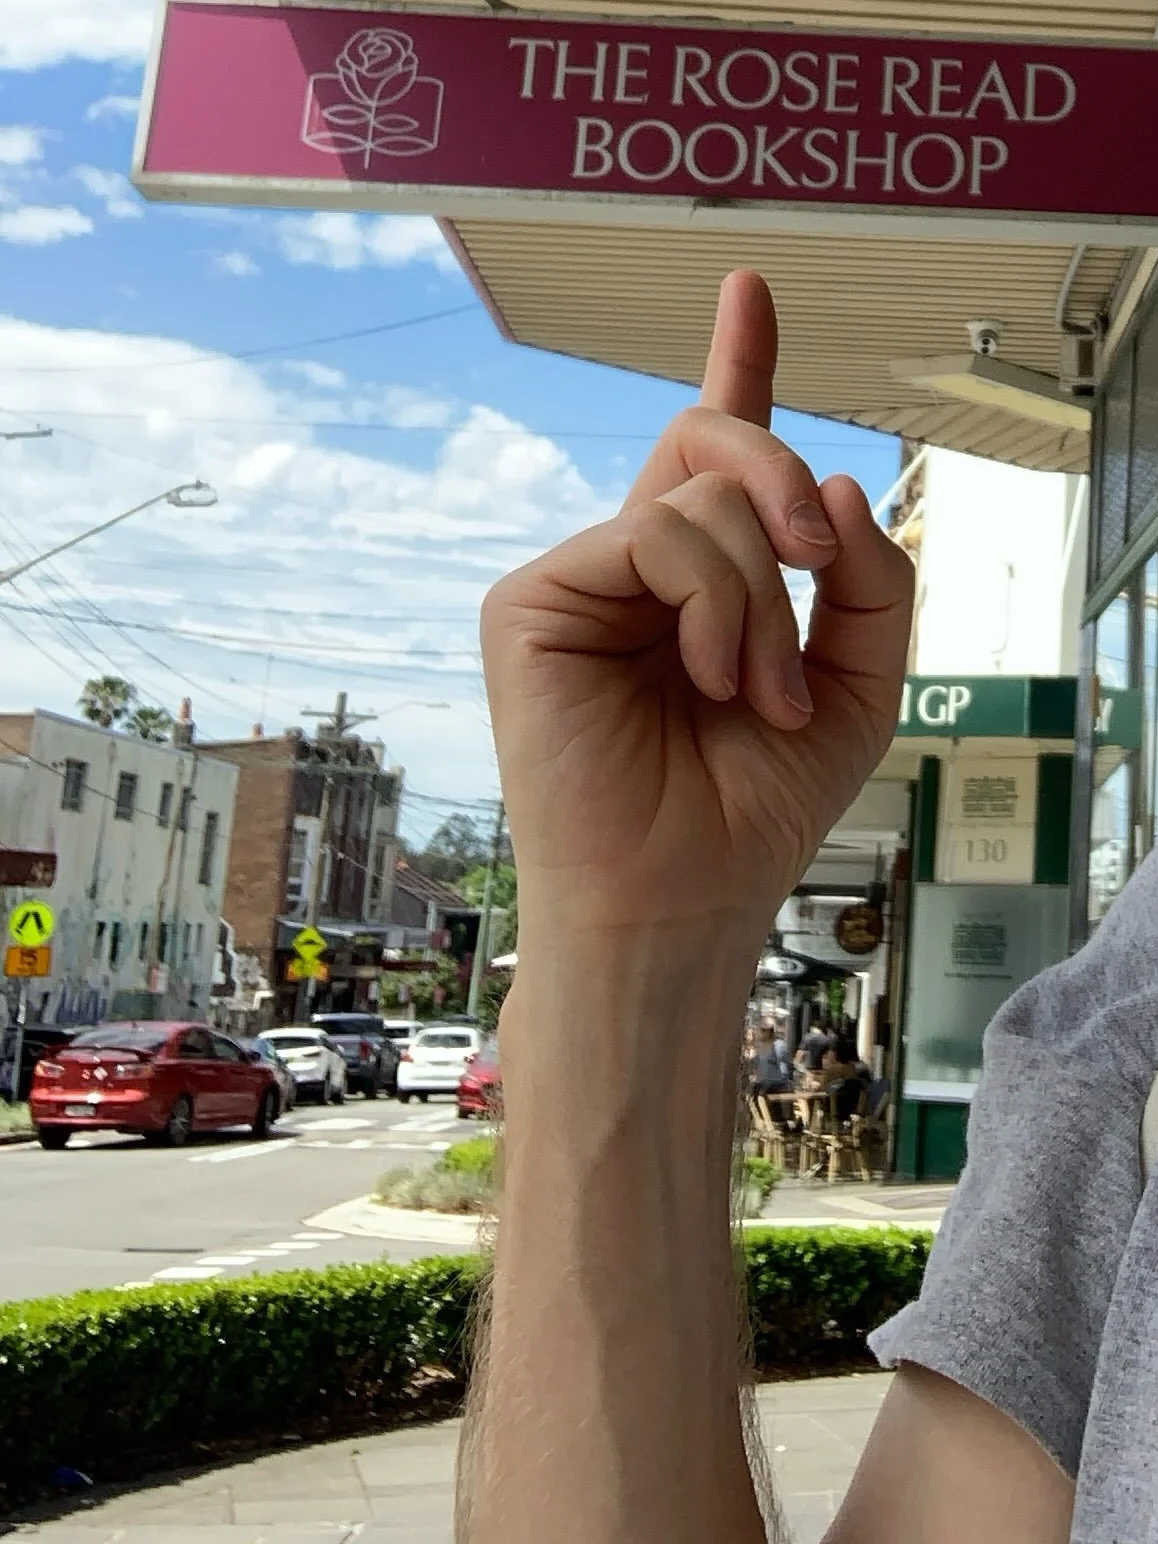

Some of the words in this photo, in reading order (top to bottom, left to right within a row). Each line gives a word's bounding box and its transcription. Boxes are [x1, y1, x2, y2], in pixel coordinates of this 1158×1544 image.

[508, 36, 651, 104] THE
[672, 45, 860, 114] ROSE
[881, 55, 1077, 123] READ
[570, 116, 1009, 196] BOOKSHOP
[917, 685, 972, 726] GP
[966, 838, 1008, 863] 130
